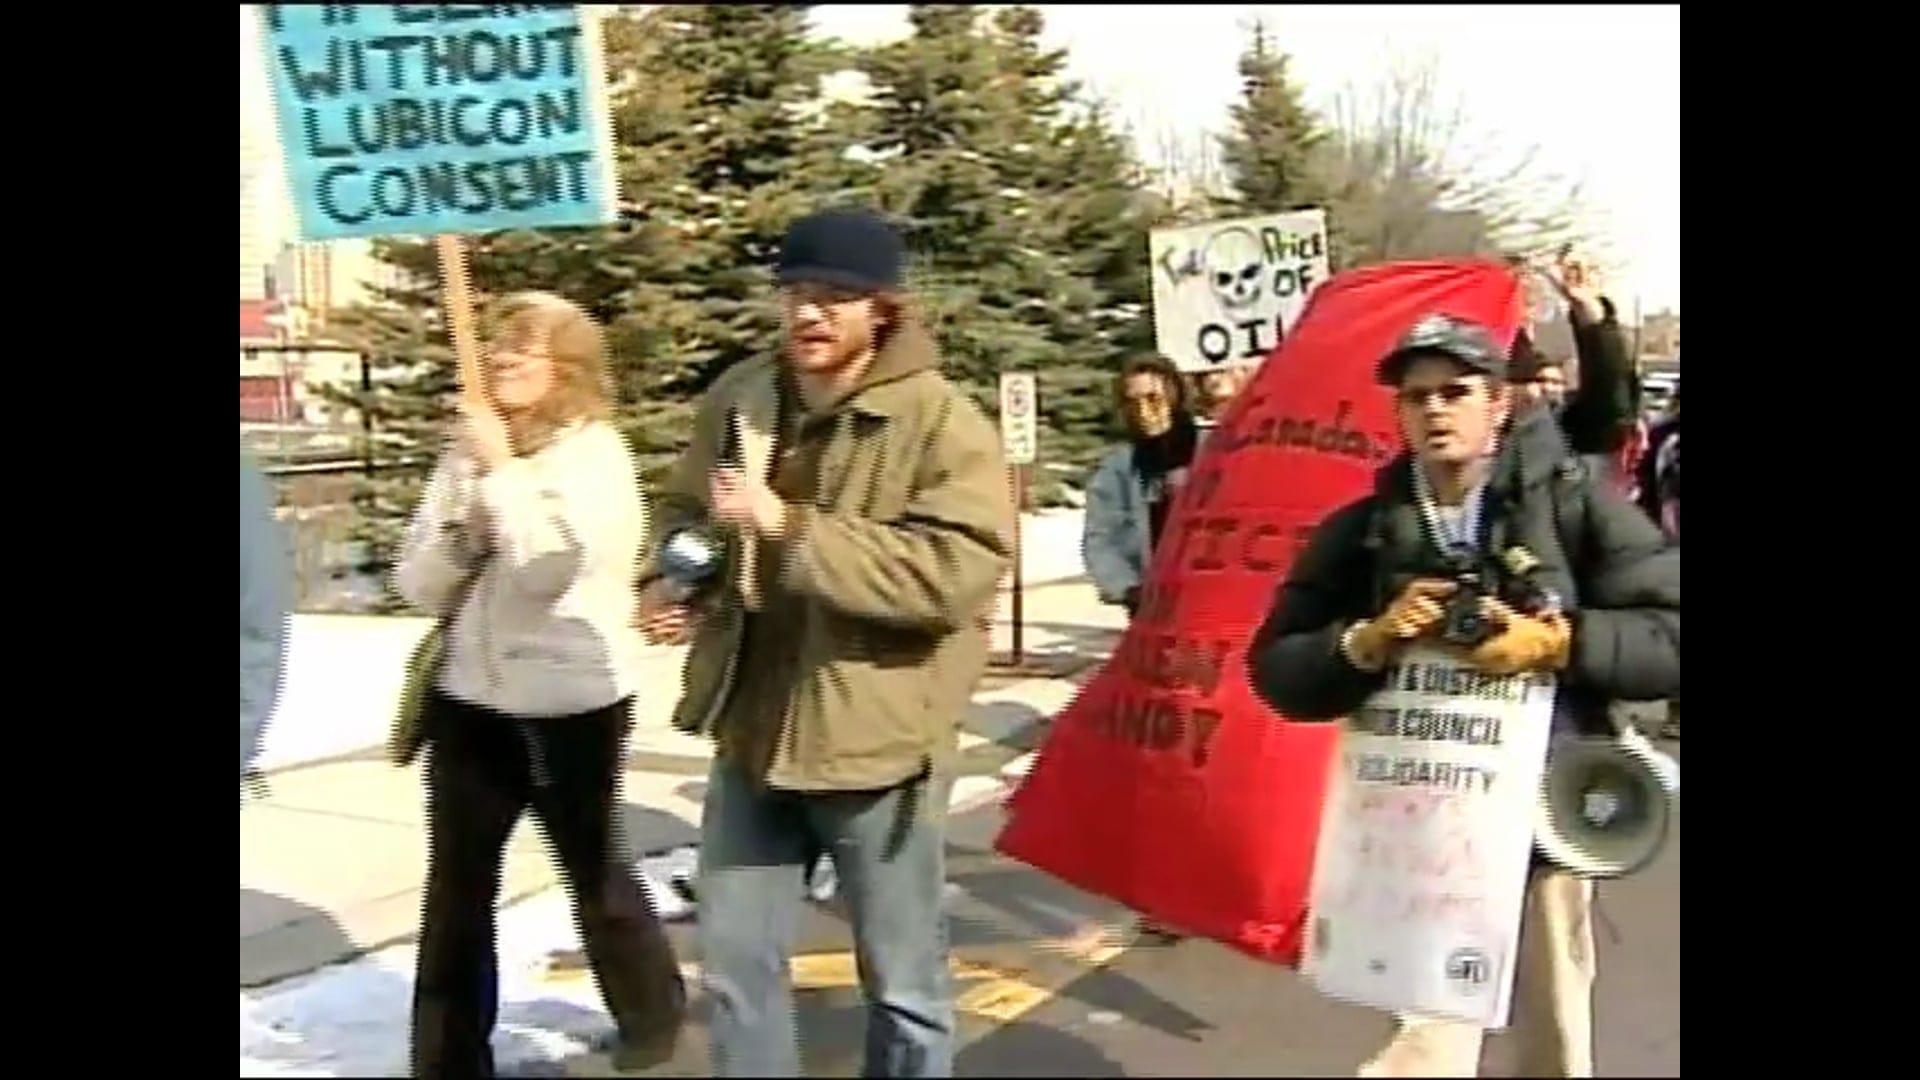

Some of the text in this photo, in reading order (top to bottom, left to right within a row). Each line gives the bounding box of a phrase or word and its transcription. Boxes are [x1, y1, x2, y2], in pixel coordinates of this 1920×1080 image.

[279, 27, 582, 100] WITHOUT
[303, 88, 580, 158] LUBICON
[315, 151, 592, 225] CONSENT
[1273, 265, 1314, 298] OF
[1402, 708, 1503, 746] COUNCIL
